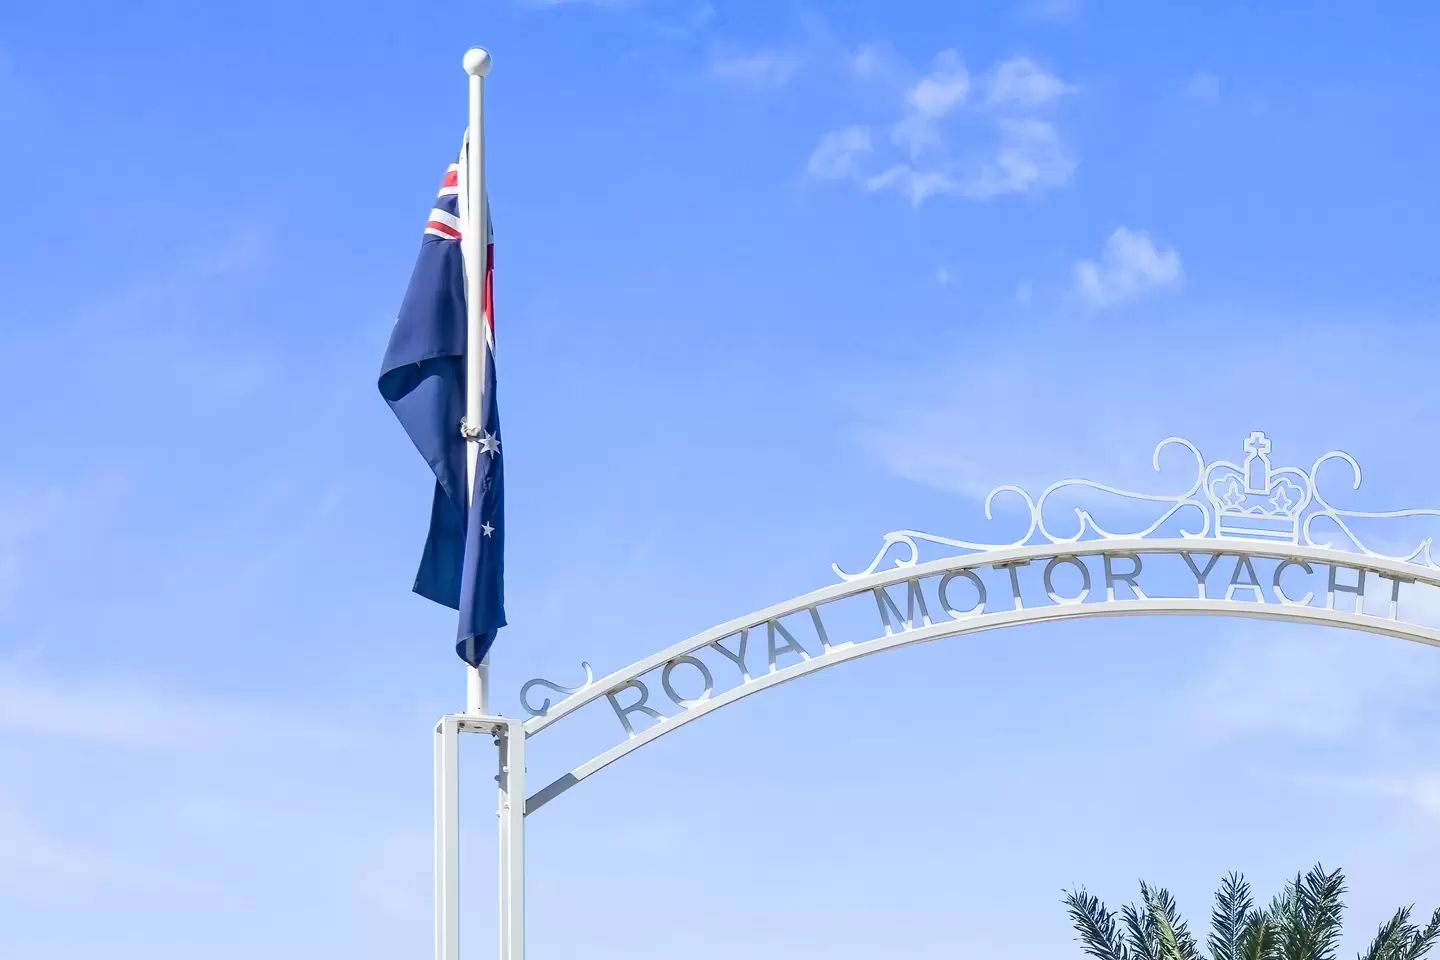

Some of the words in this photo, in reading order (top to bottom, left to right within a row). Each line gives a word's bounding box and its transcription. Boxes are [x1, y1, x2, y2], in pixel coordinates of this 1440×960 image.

[604, 606, 855, 739] ROYAL
[872, 552, 1146, 637] MOTOR
[1179, 552, 1415, 621] YACHT
